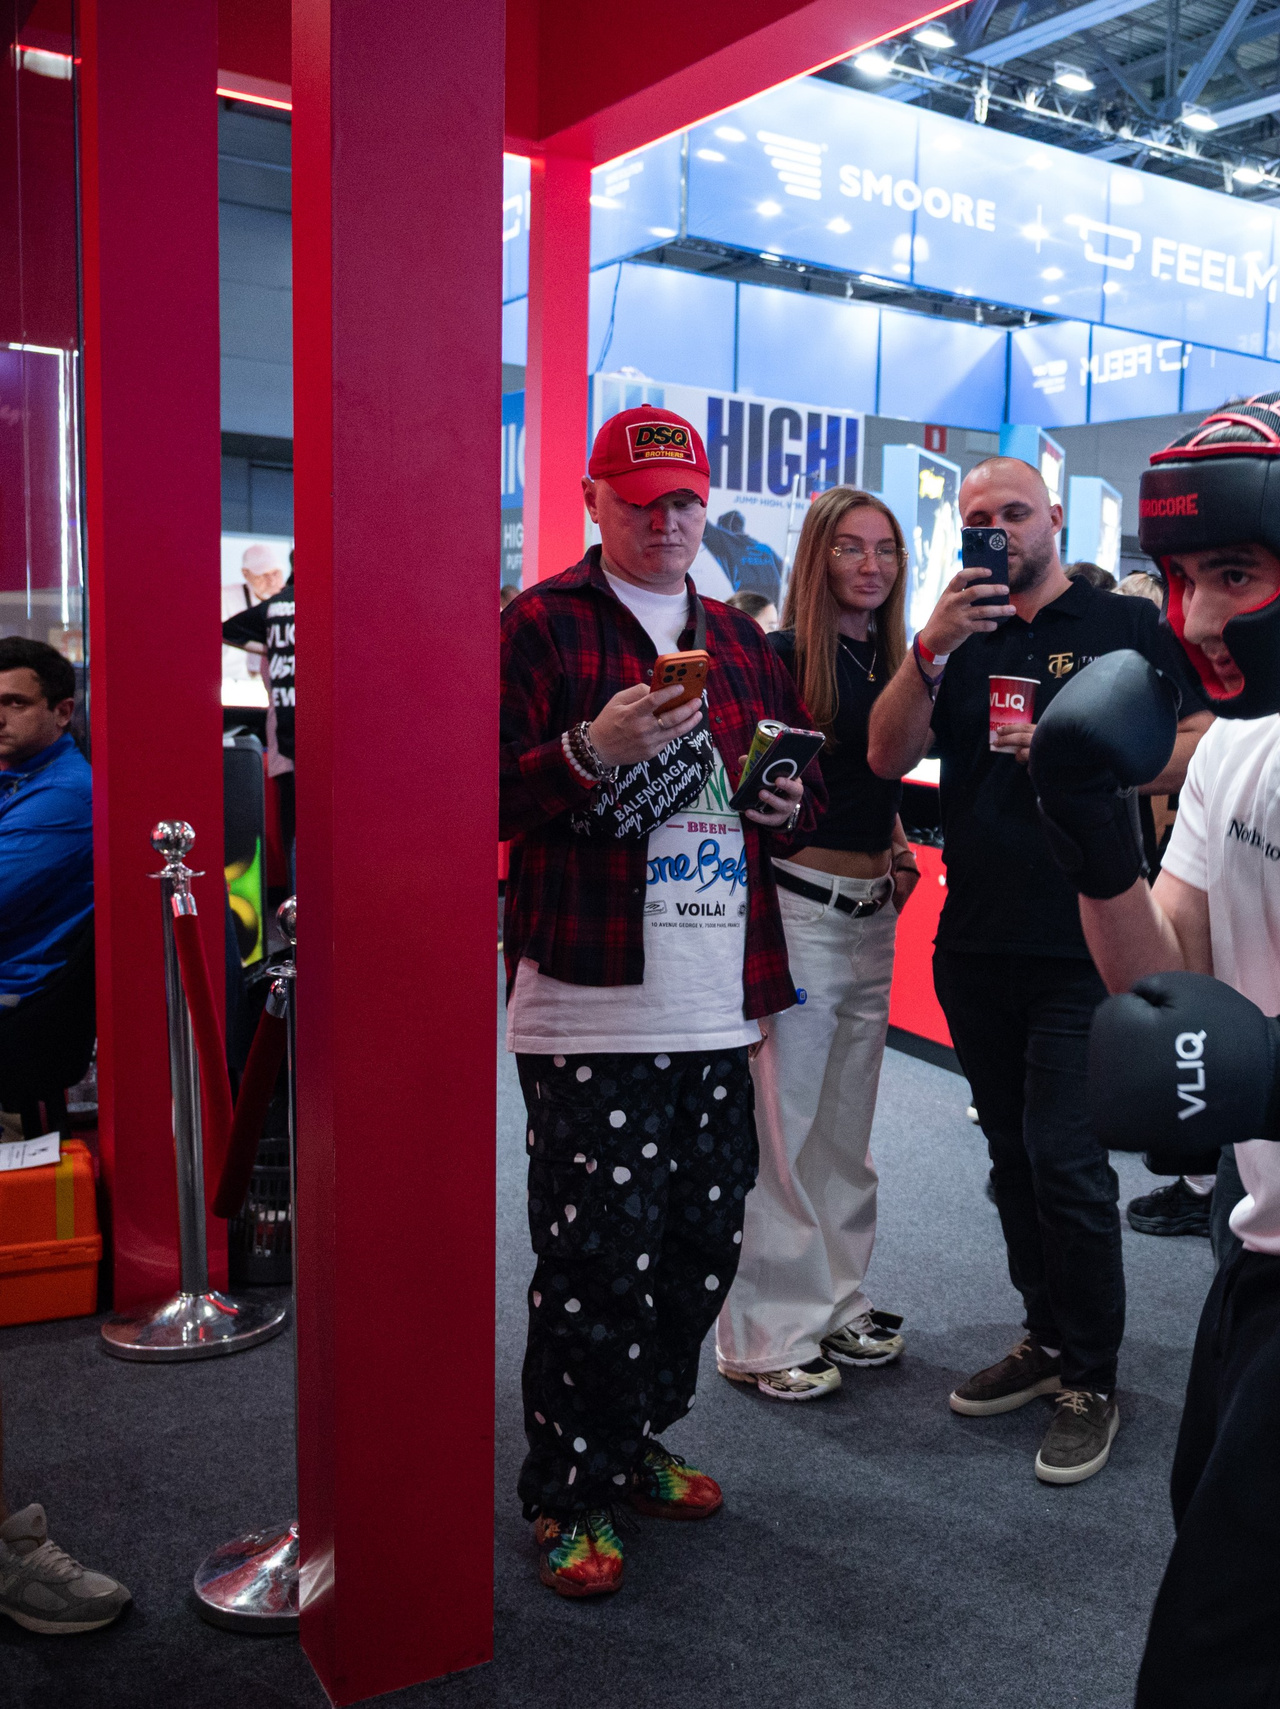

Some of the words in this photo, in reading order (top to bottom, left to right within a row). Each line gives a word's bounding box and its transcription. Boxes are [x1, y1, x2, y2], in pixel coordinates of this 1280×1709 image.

[839, 164, 996, 232] SMOORE
[1152, 237, 1278, 304] FEELM
[635, 426, 688, 449] DSQ
[990, 692, 1025, 712] VLIQ
[614, 760, 688, 822] BALENCIAGA
[687, 821, 727, 835] BEEN
[675, 900, 726, 917] VOILÀ!
[1175, 1029, 1208, 1121] VLIQ
